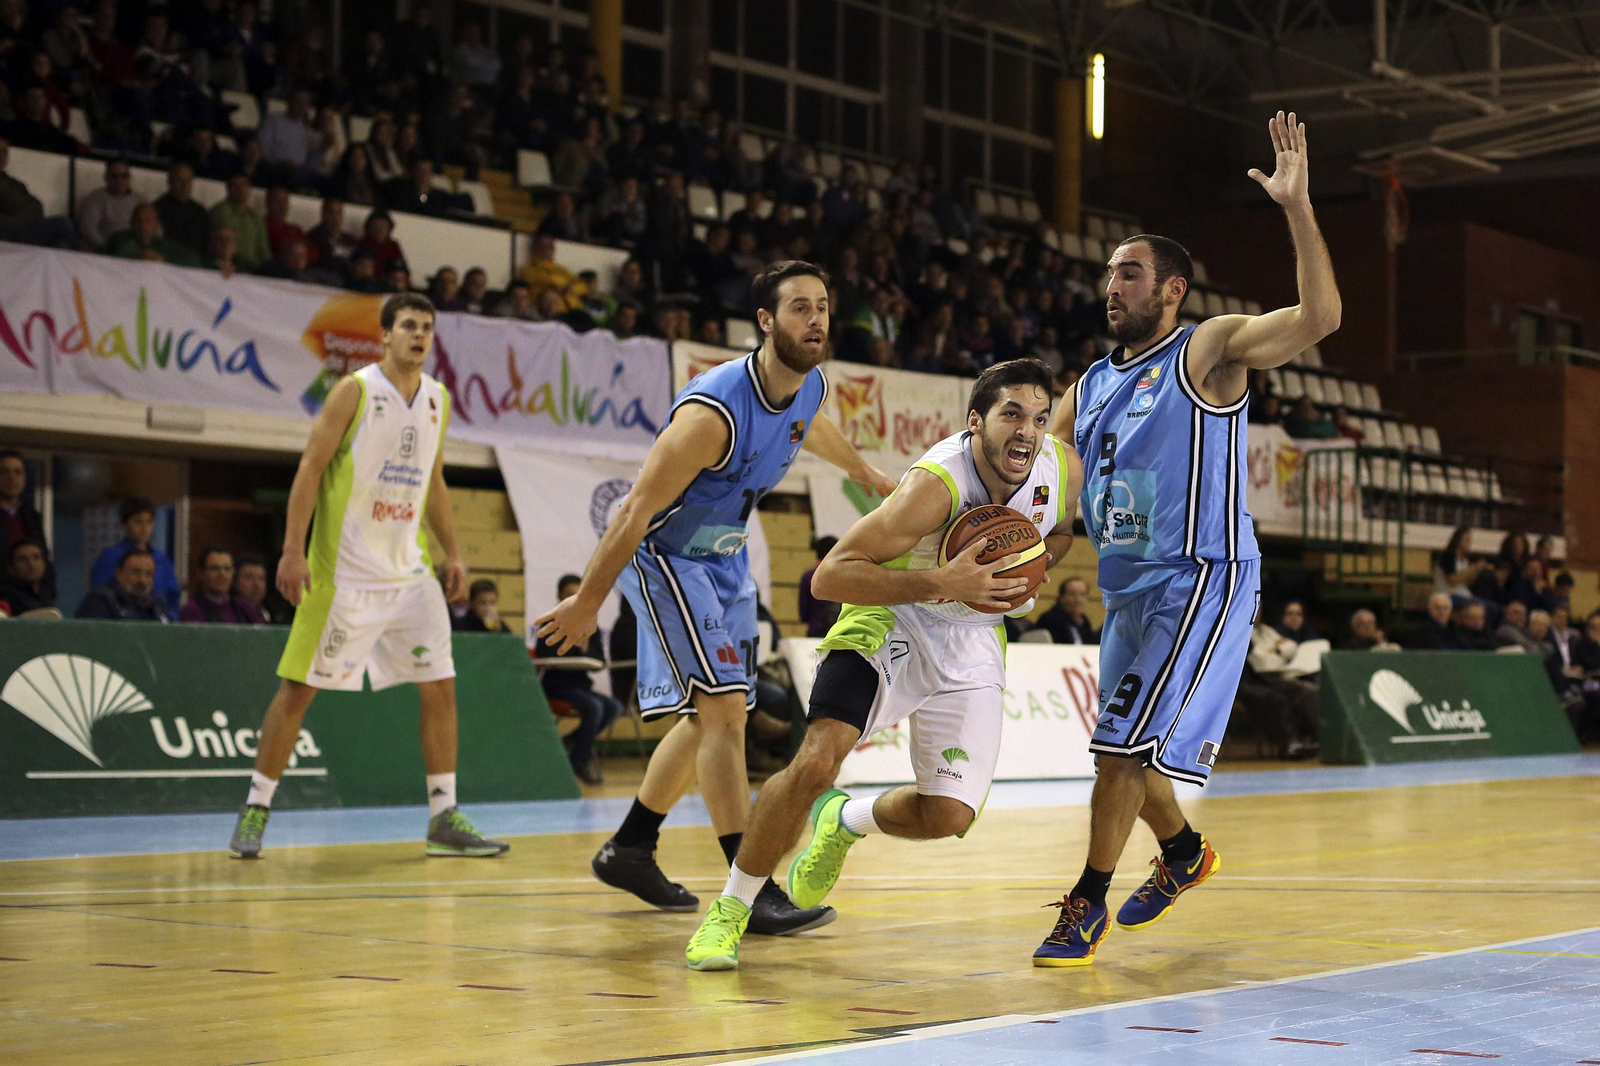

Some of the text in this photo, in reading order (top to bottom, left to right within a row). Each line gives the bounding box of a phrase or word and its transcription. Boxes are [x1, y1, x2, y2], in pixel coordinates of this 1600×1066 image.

[1099, 432, 1118, 478] 9
[968, 506, 1001, 528] FIBA
[1421, 698, 1487, 734] Unicaja
[150, 709, 322, 768] Unica
[936, 767, 963, 779] Unicaja
